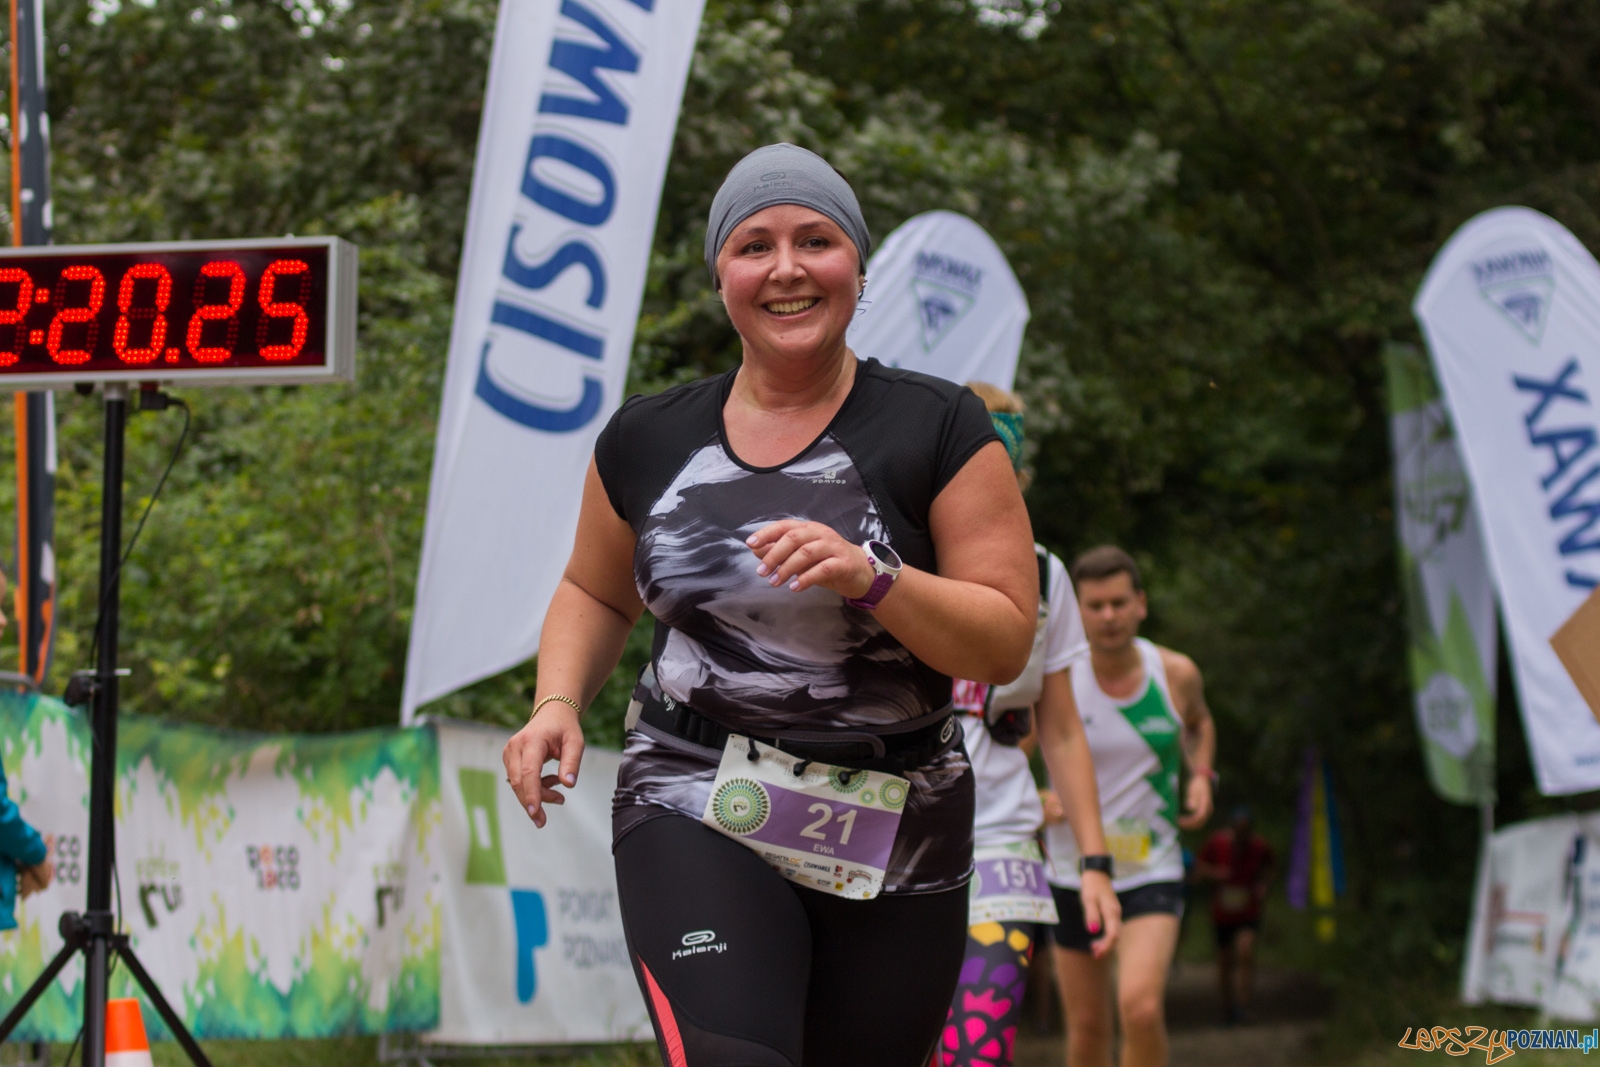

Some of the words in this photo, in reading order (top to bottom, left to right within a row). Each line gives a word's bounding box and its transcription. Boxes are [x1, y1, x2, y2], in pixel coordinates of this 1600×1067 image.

[475, 0, 655, 433] CISOW
[1512, 356, 1600, 590] XAW
[799, 802, 858, 845] 21
[813, 844, 835, 856] EWA
[993, 859, 1038, 890] 151
[671, 942, 728, 961] Kalenji
